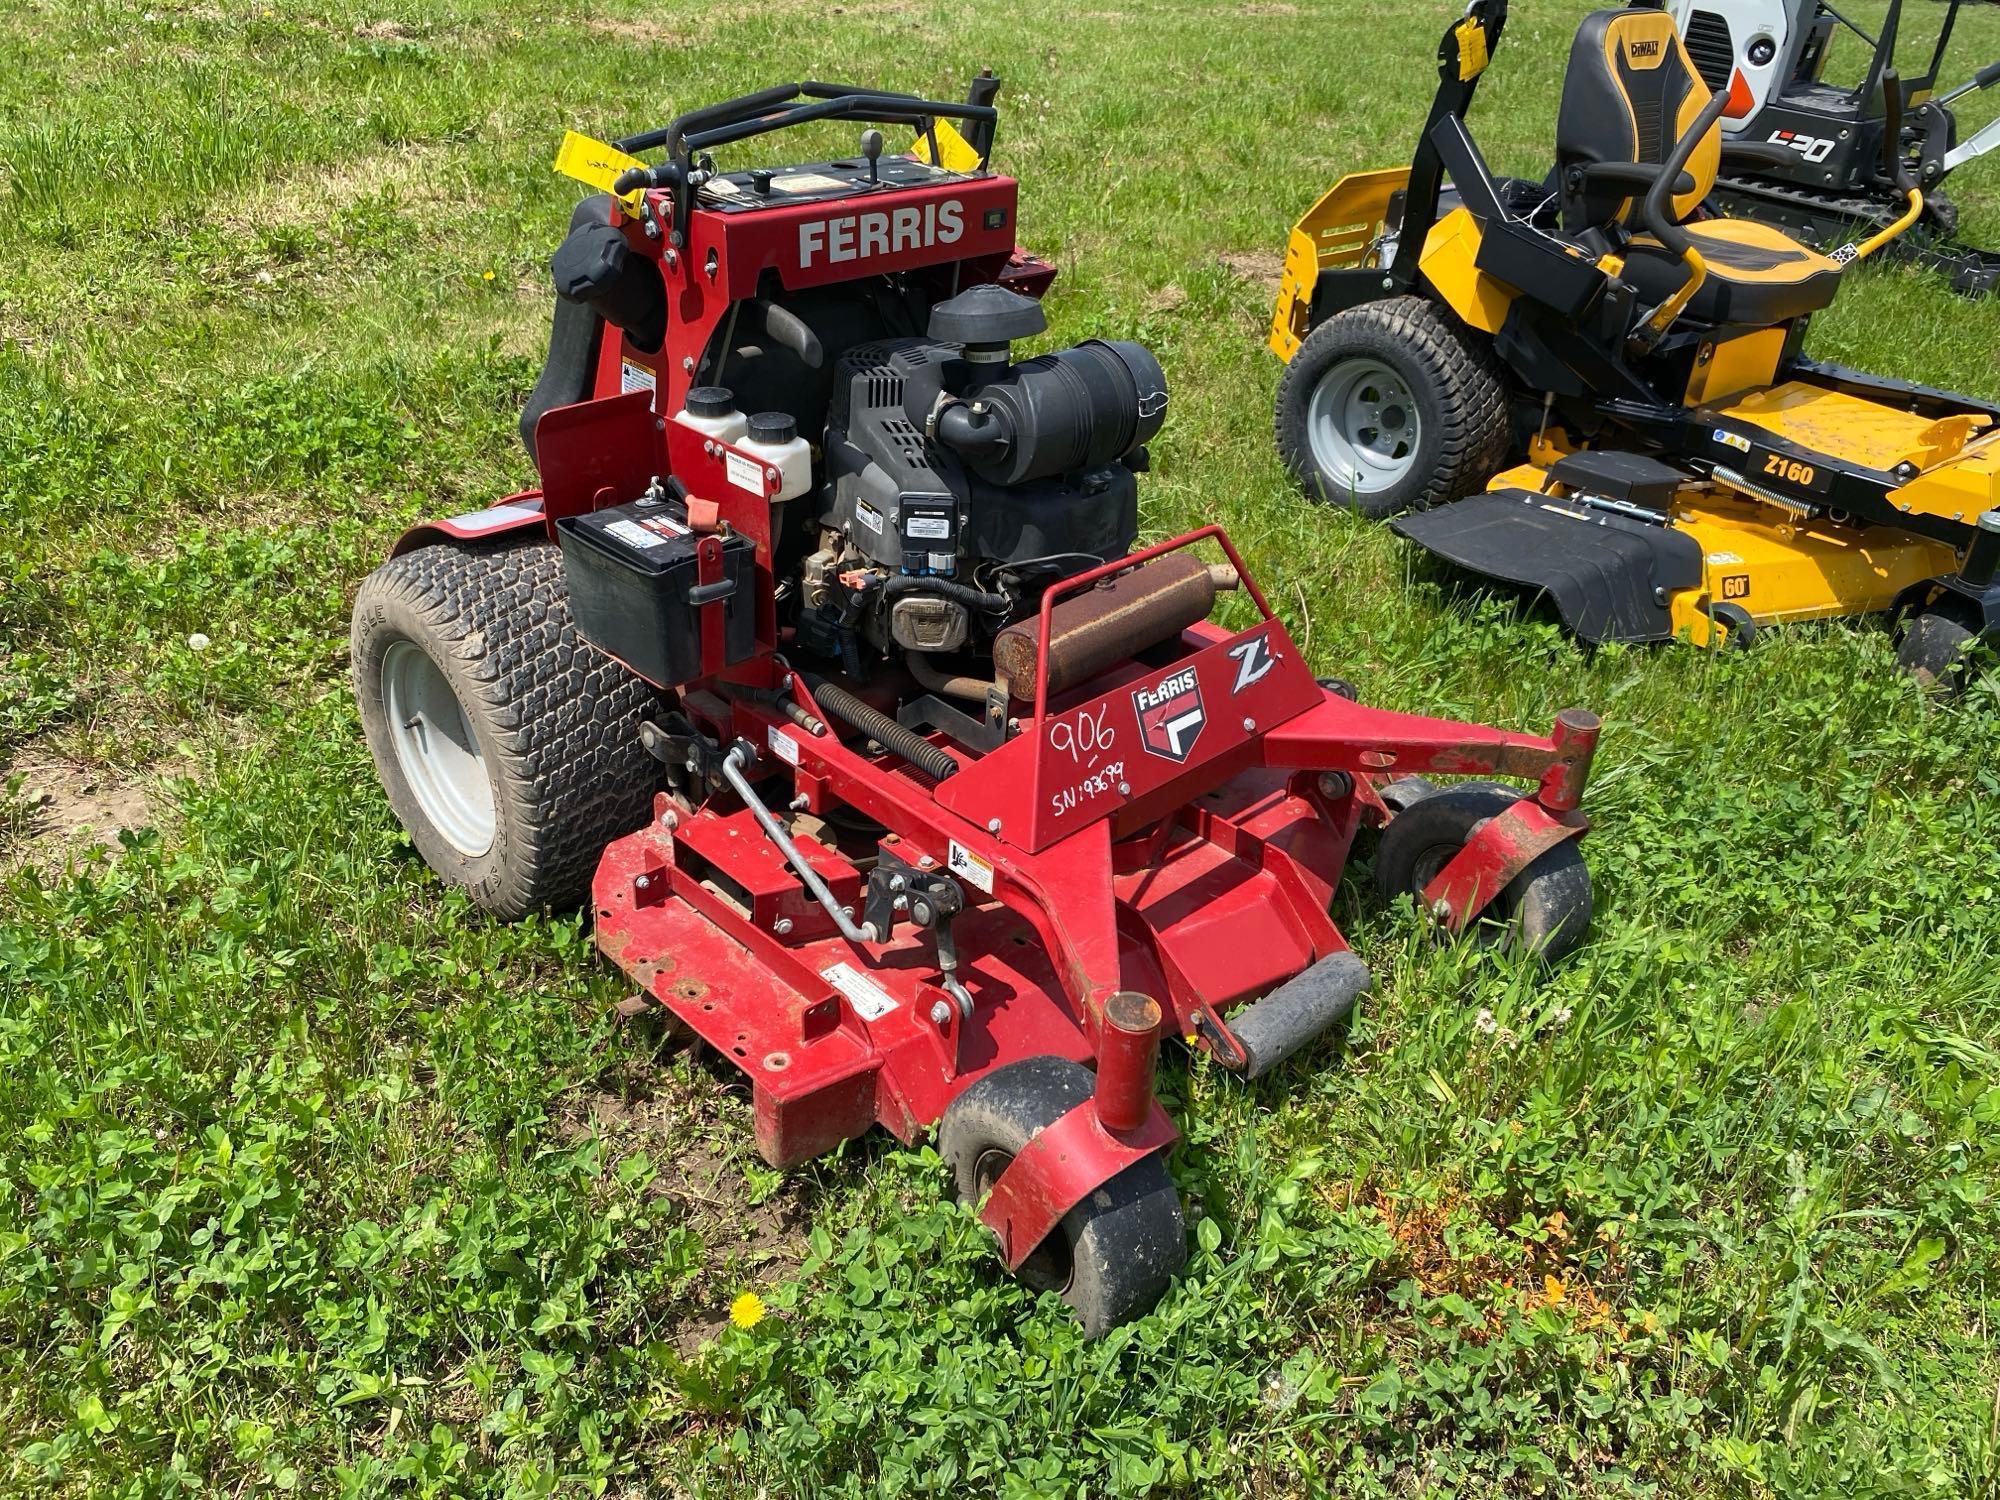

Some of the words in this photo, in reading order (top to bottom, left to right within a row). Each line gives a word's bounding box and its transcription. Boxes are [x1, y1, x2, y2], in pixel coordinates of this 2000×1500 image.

[799, 200, 964, 269] FERRIS
[1764, 454, 1814, 485] Z160
[1137, 670, 1195, 711] FERRIS
[1050, 702, 1115, 763] 906
